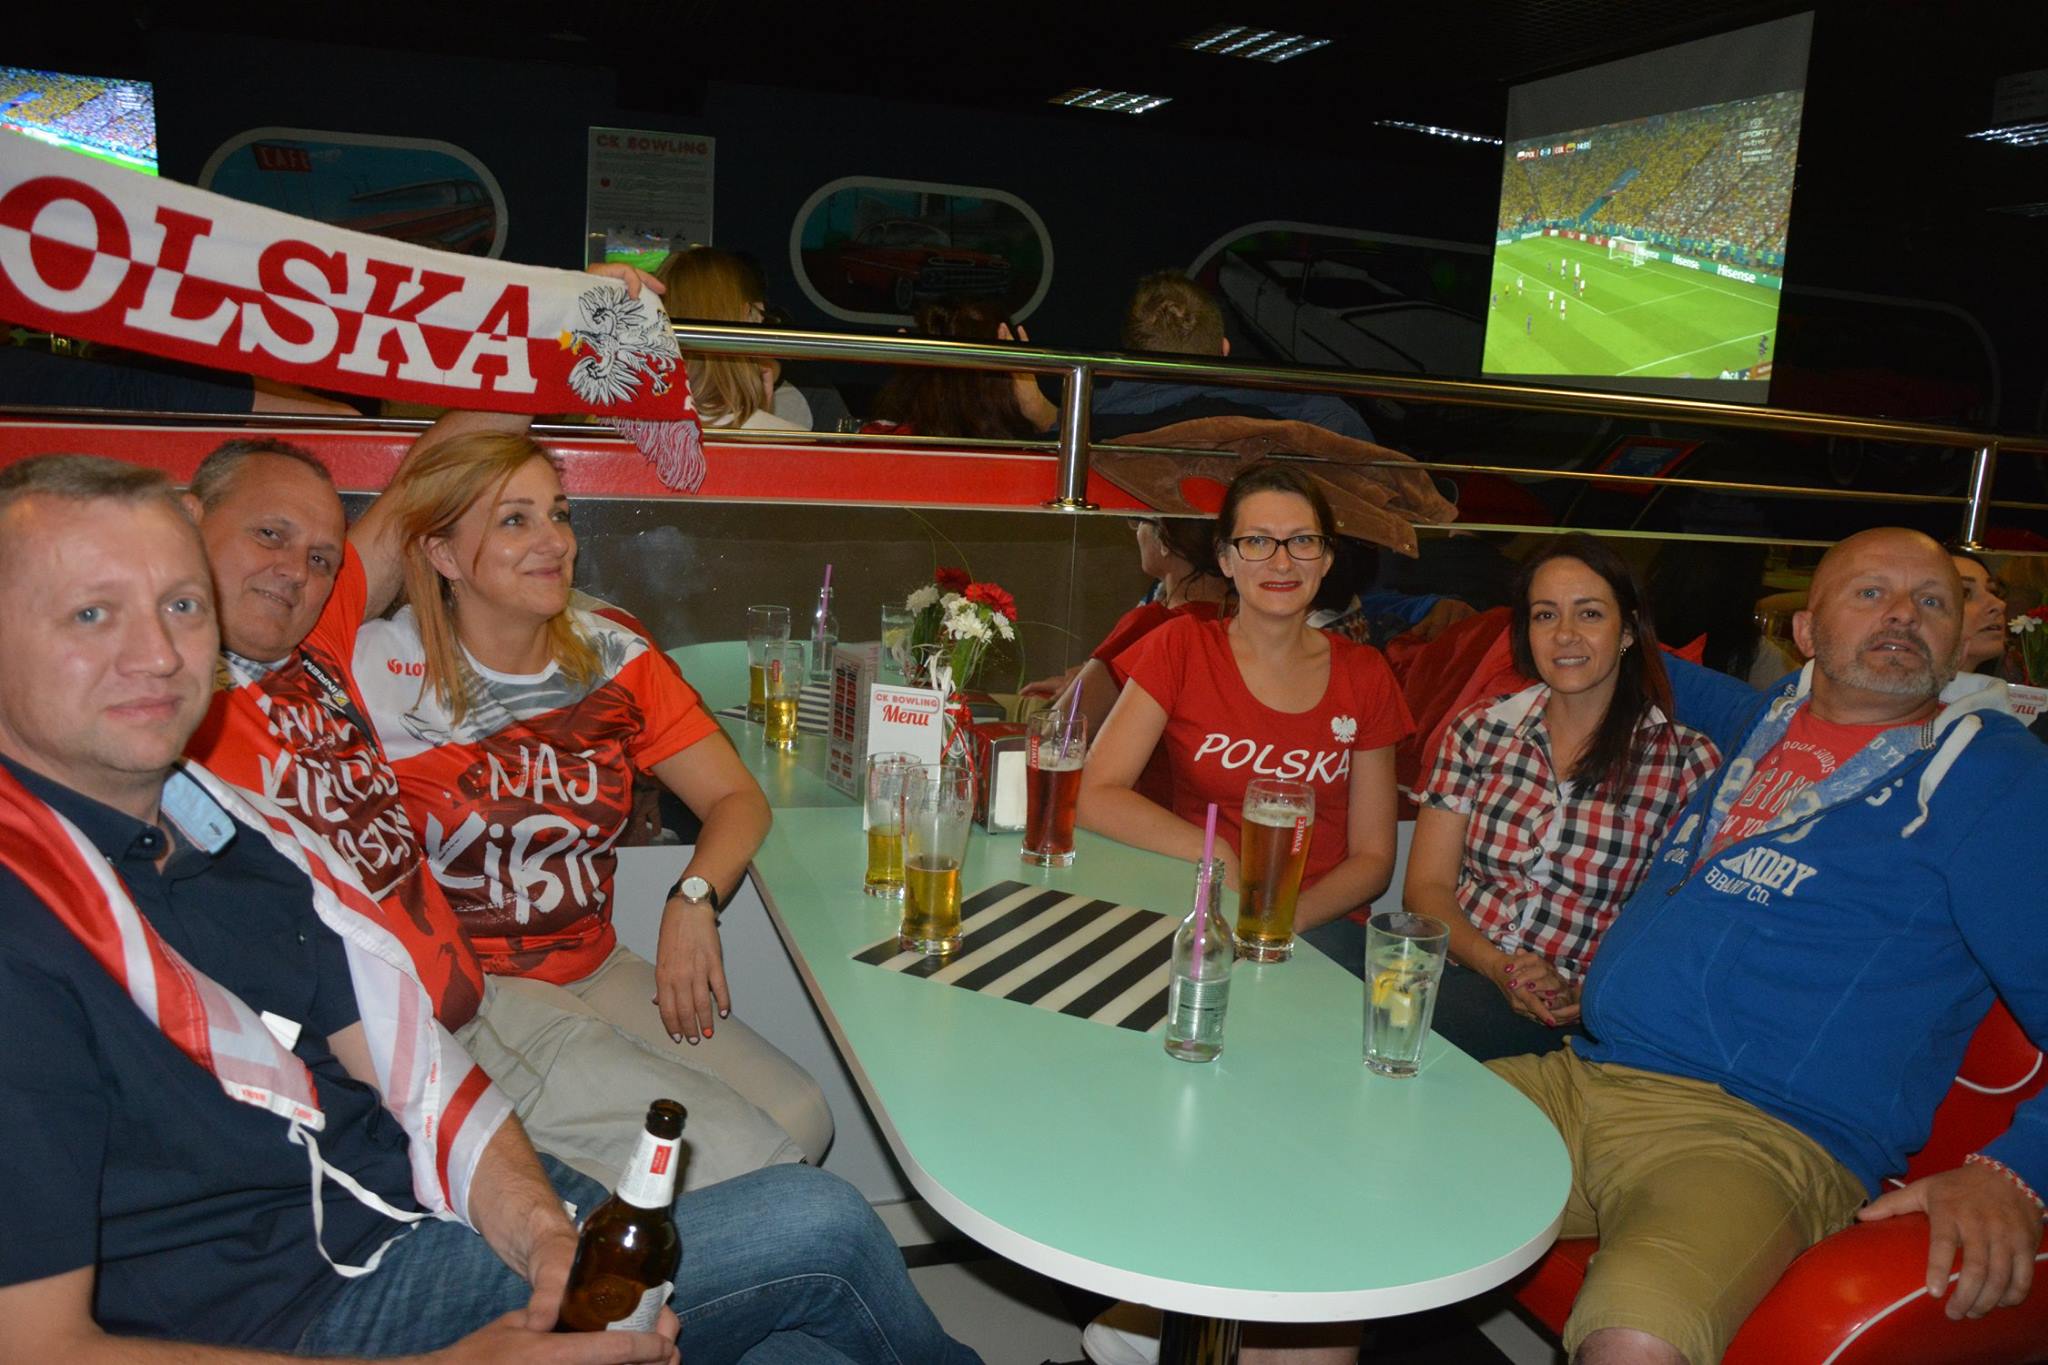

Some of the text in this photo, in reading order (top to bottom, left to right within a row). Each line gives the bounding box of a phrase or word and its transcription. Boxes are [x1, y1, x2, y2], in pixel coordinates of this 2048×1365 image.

[627, 137, 709, 155] BOWLING
[1717, 264, 1757, 284] Hisense
[875, 693, 938, 708] CK BOWLING
[882, 703, 930, 727] Menu
[1194, 733, 1350, 784] POLSKA
[487, 743, 599, 805] NAJ
